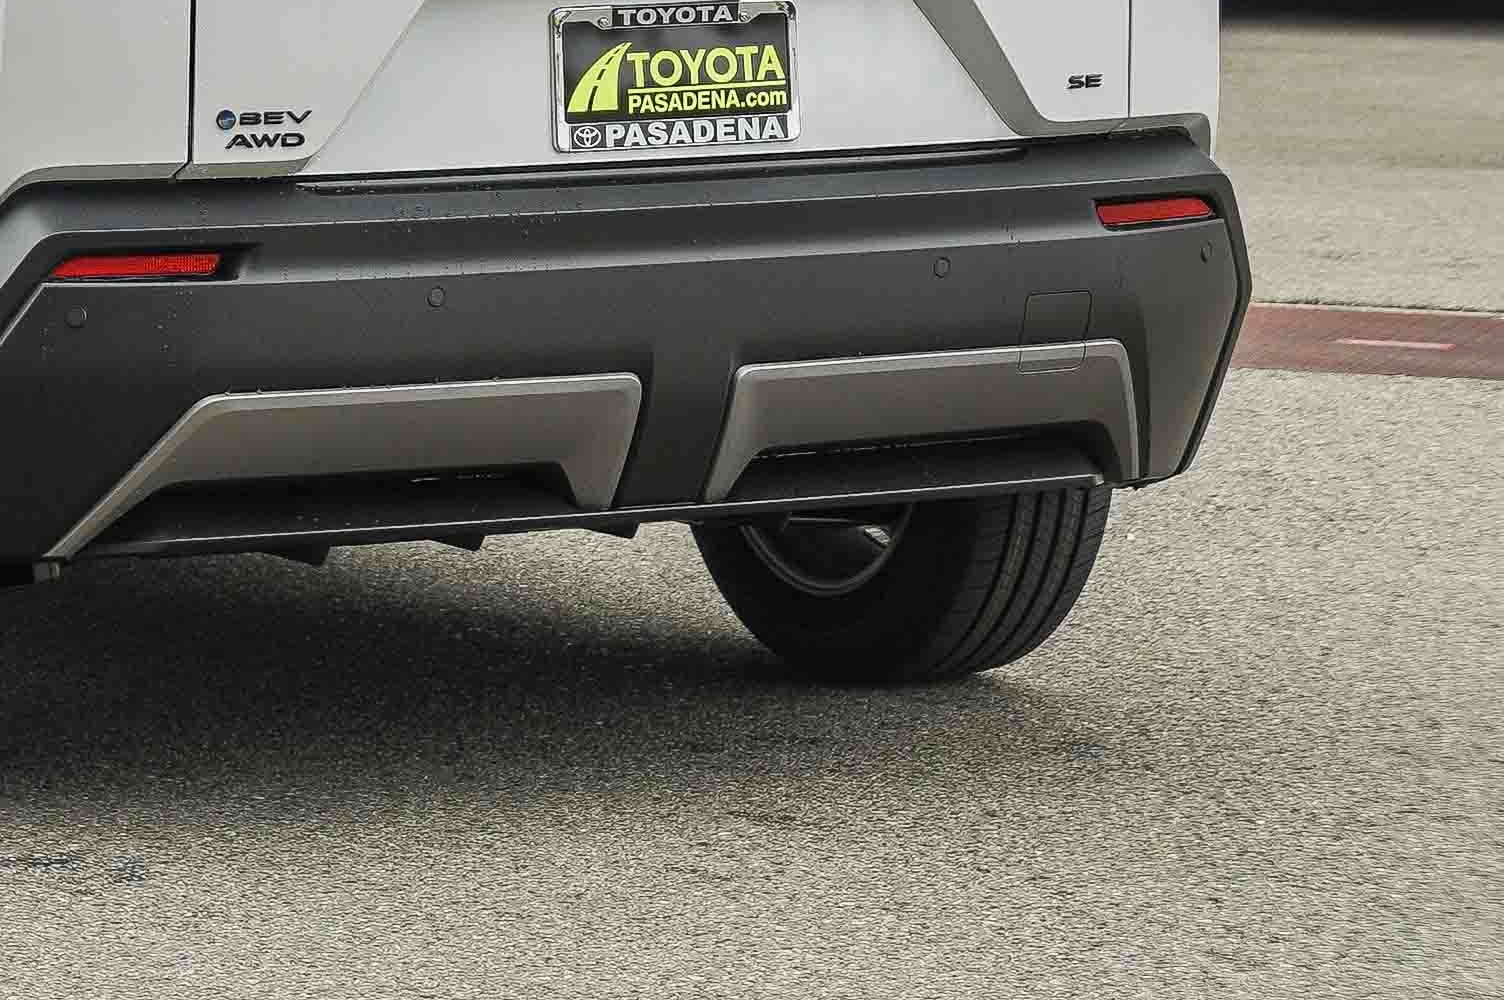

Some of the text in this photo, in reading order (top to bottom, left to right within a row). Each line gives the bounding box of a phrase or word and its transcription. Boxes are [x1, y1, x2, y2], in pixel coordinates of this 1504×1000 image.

[618, 4, 734, 26] TOYOTA
[626, 44, 786, 88] TOYOTA
[1066, 73, 1104, 89] SE
[628, 90, 787, 114] PASADENA.com
[239, 110, 313, 126] BEV
[225, 132, 306, 149] AWD
[605, 115, 786, 147] PASADENA
